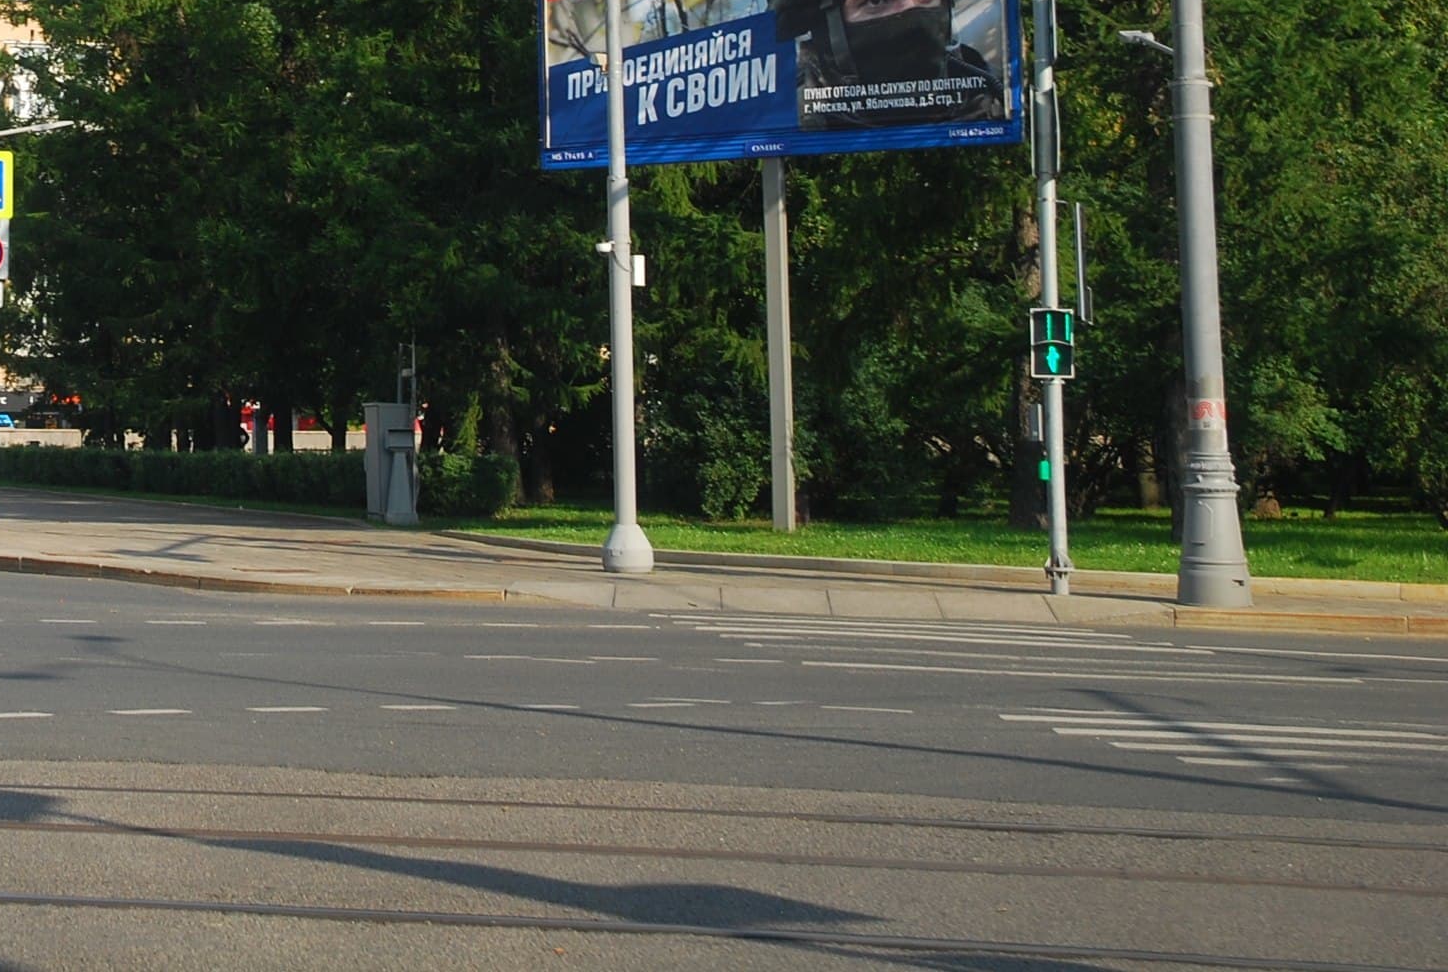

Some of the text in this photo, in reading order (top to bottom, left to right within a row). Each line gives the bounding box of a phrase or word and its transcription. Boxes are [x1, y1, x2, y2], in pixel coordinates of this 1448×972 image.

[568, 29, 752, 101] ПРИОЕДИНЯЙСЯ
[804, 75, 987, 100] ПУНКТ ОТБОРА НА СЛУЖБУ ПО КОНТРАКТУ:
[638, 54, 777, 125] К СВОИМ
[804, 104, 812, 114] г.
[813, 101, 850, 113] Москва,
[851, 100, 864, 113] ул.
[866, 96, 918, 109] Яблочкова,
[936, 94, 955, 107] стр.
